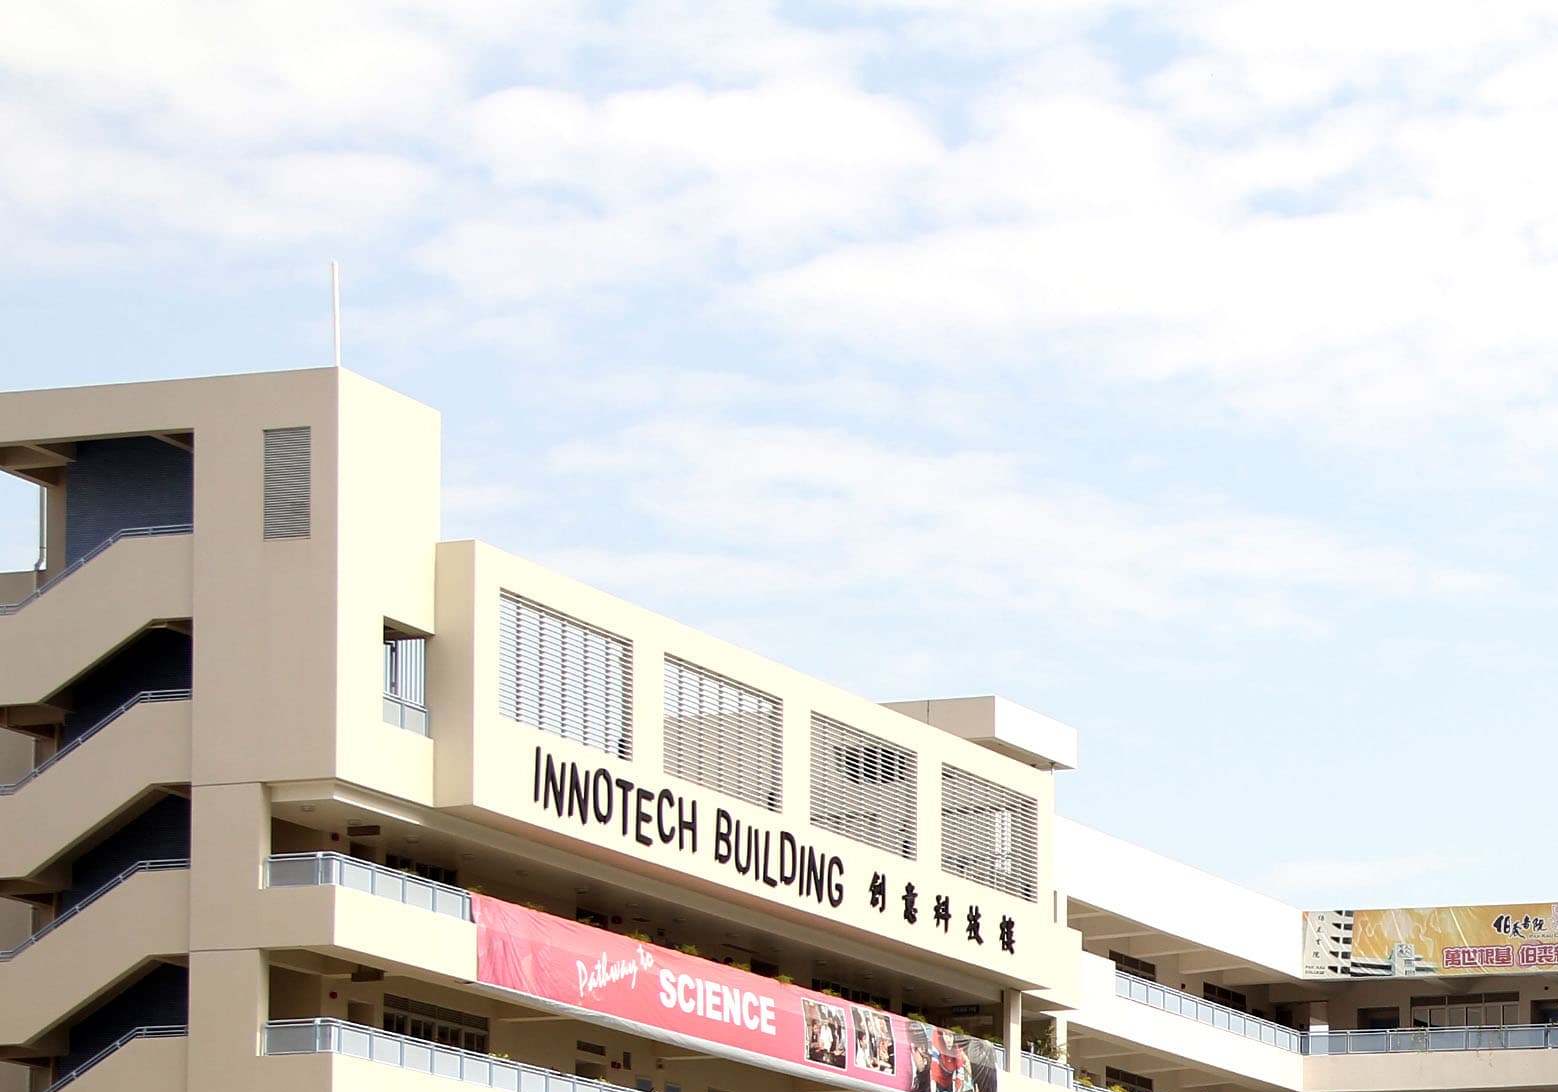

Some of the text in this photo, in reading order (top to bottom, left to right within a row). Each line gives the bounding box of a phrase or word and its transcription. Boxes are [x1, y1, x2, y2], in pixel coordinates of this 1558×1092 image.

[533, 745, 846, 907] INNOTECH BUILDING
[868, 871, 1017, 955] 創意科技樓
[575, 944, 655, 996] Pathway to
[1443, 947, 1514, 968] 萬世根基
[658, 968, 777, 1035] SCIENCE
